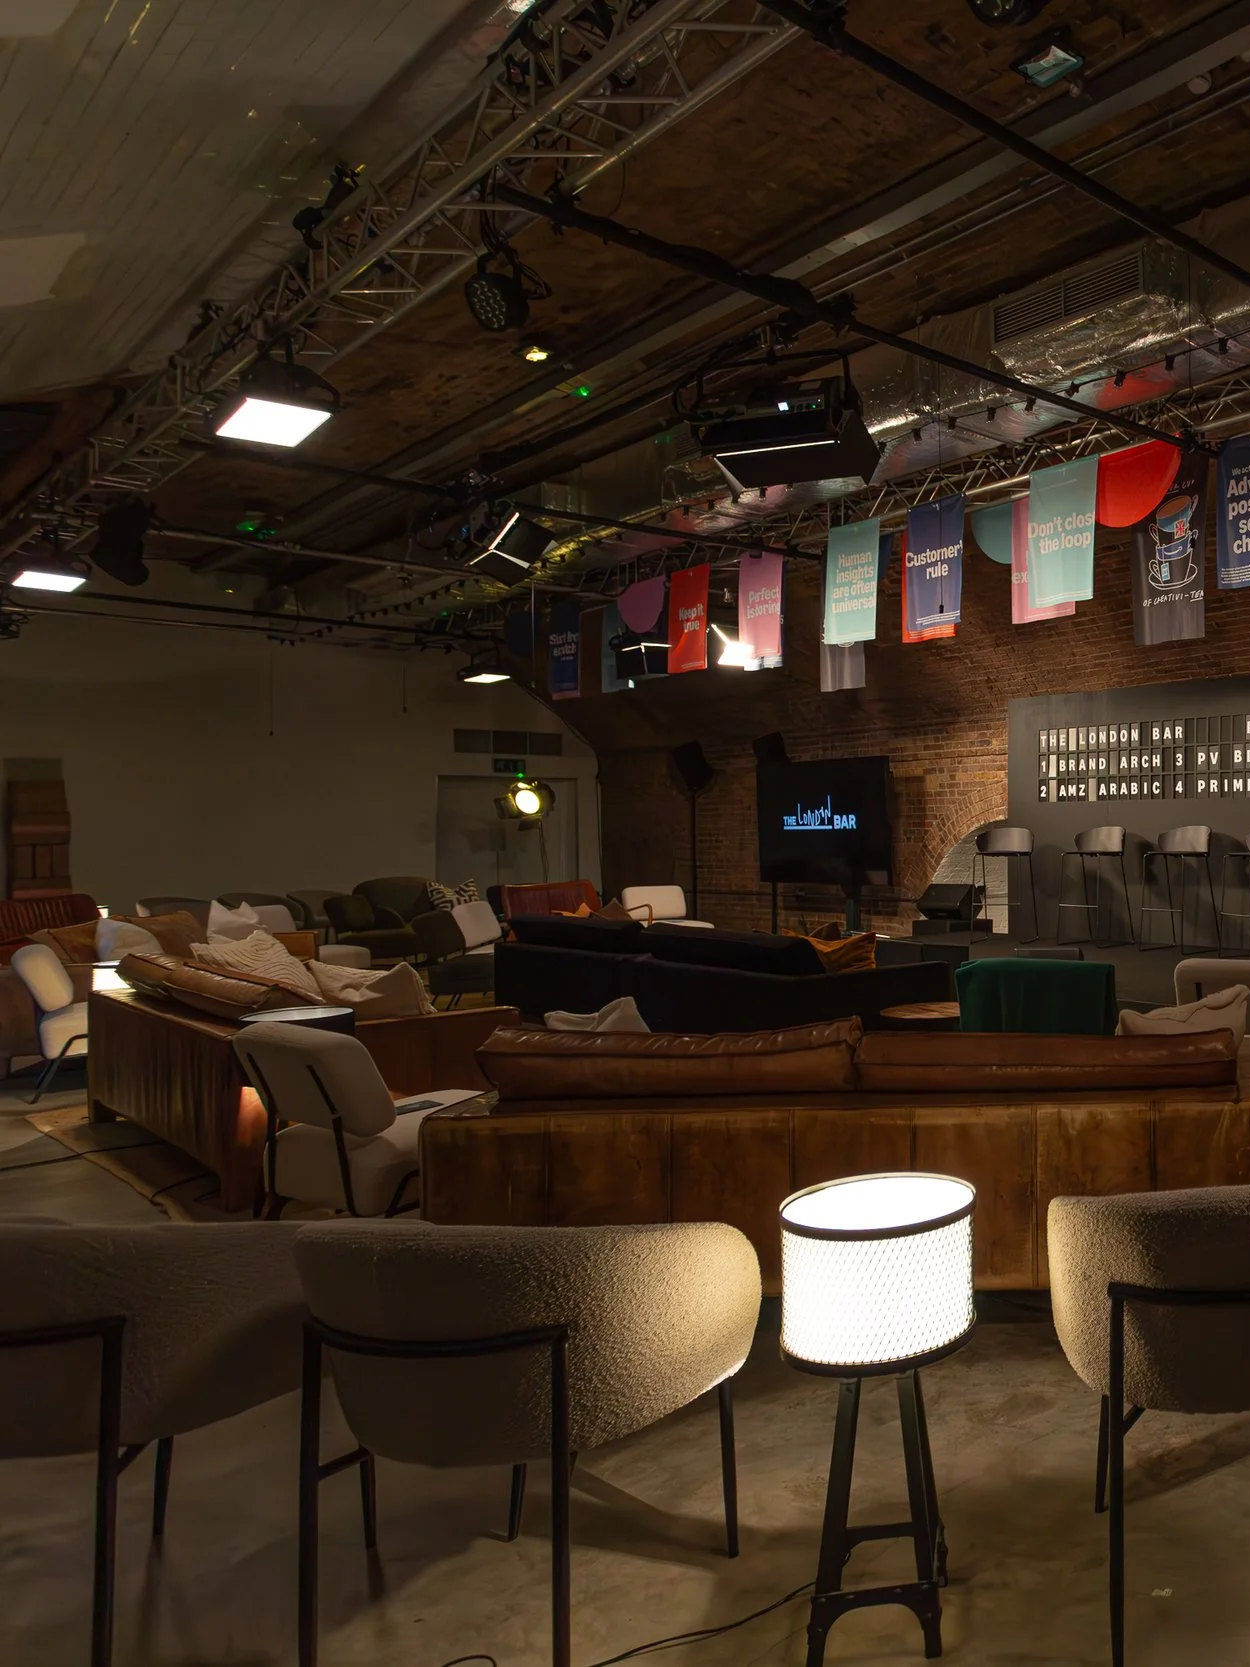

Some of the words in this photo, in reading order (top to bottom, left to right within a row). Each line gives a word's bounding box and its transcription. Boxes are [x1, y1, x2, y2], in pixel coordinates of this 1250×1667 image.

[1027, 516, 1063, 539] Don't
[1039, 537, 1060, 554] the
[1061, 531, 1091, 549] loop
[838, 552, 872, 568] Human
[836, 565, 875, 585] insights
[926, 561, 949, 580] rule
[832, 586, 850, 600] are
[1040, 734, 1066, 748] THE
[1079, 728, 1139, 745] LONDON
[1152, 726, 1183, 740] BAR
[1041, 761, 1046, 772] 1
[1059, 758, 1107, 772] BRAND
[1120, 755, 1161, 769] ARCH
[1175, 753, 1183, 766] 3
[1197, 751, 1219, 765] PV
[1040, 785, 1047, 798] 2
[1059, 784, 1086, 797] AMZ
[1098, 781, 1161, 795] ARABIC
[1175, 781, 1183, 793] 4
[783, 815, 797, 826] THE
[797, 795, 831, 827] LONDON
[833, 814, 857, 829] BAR
